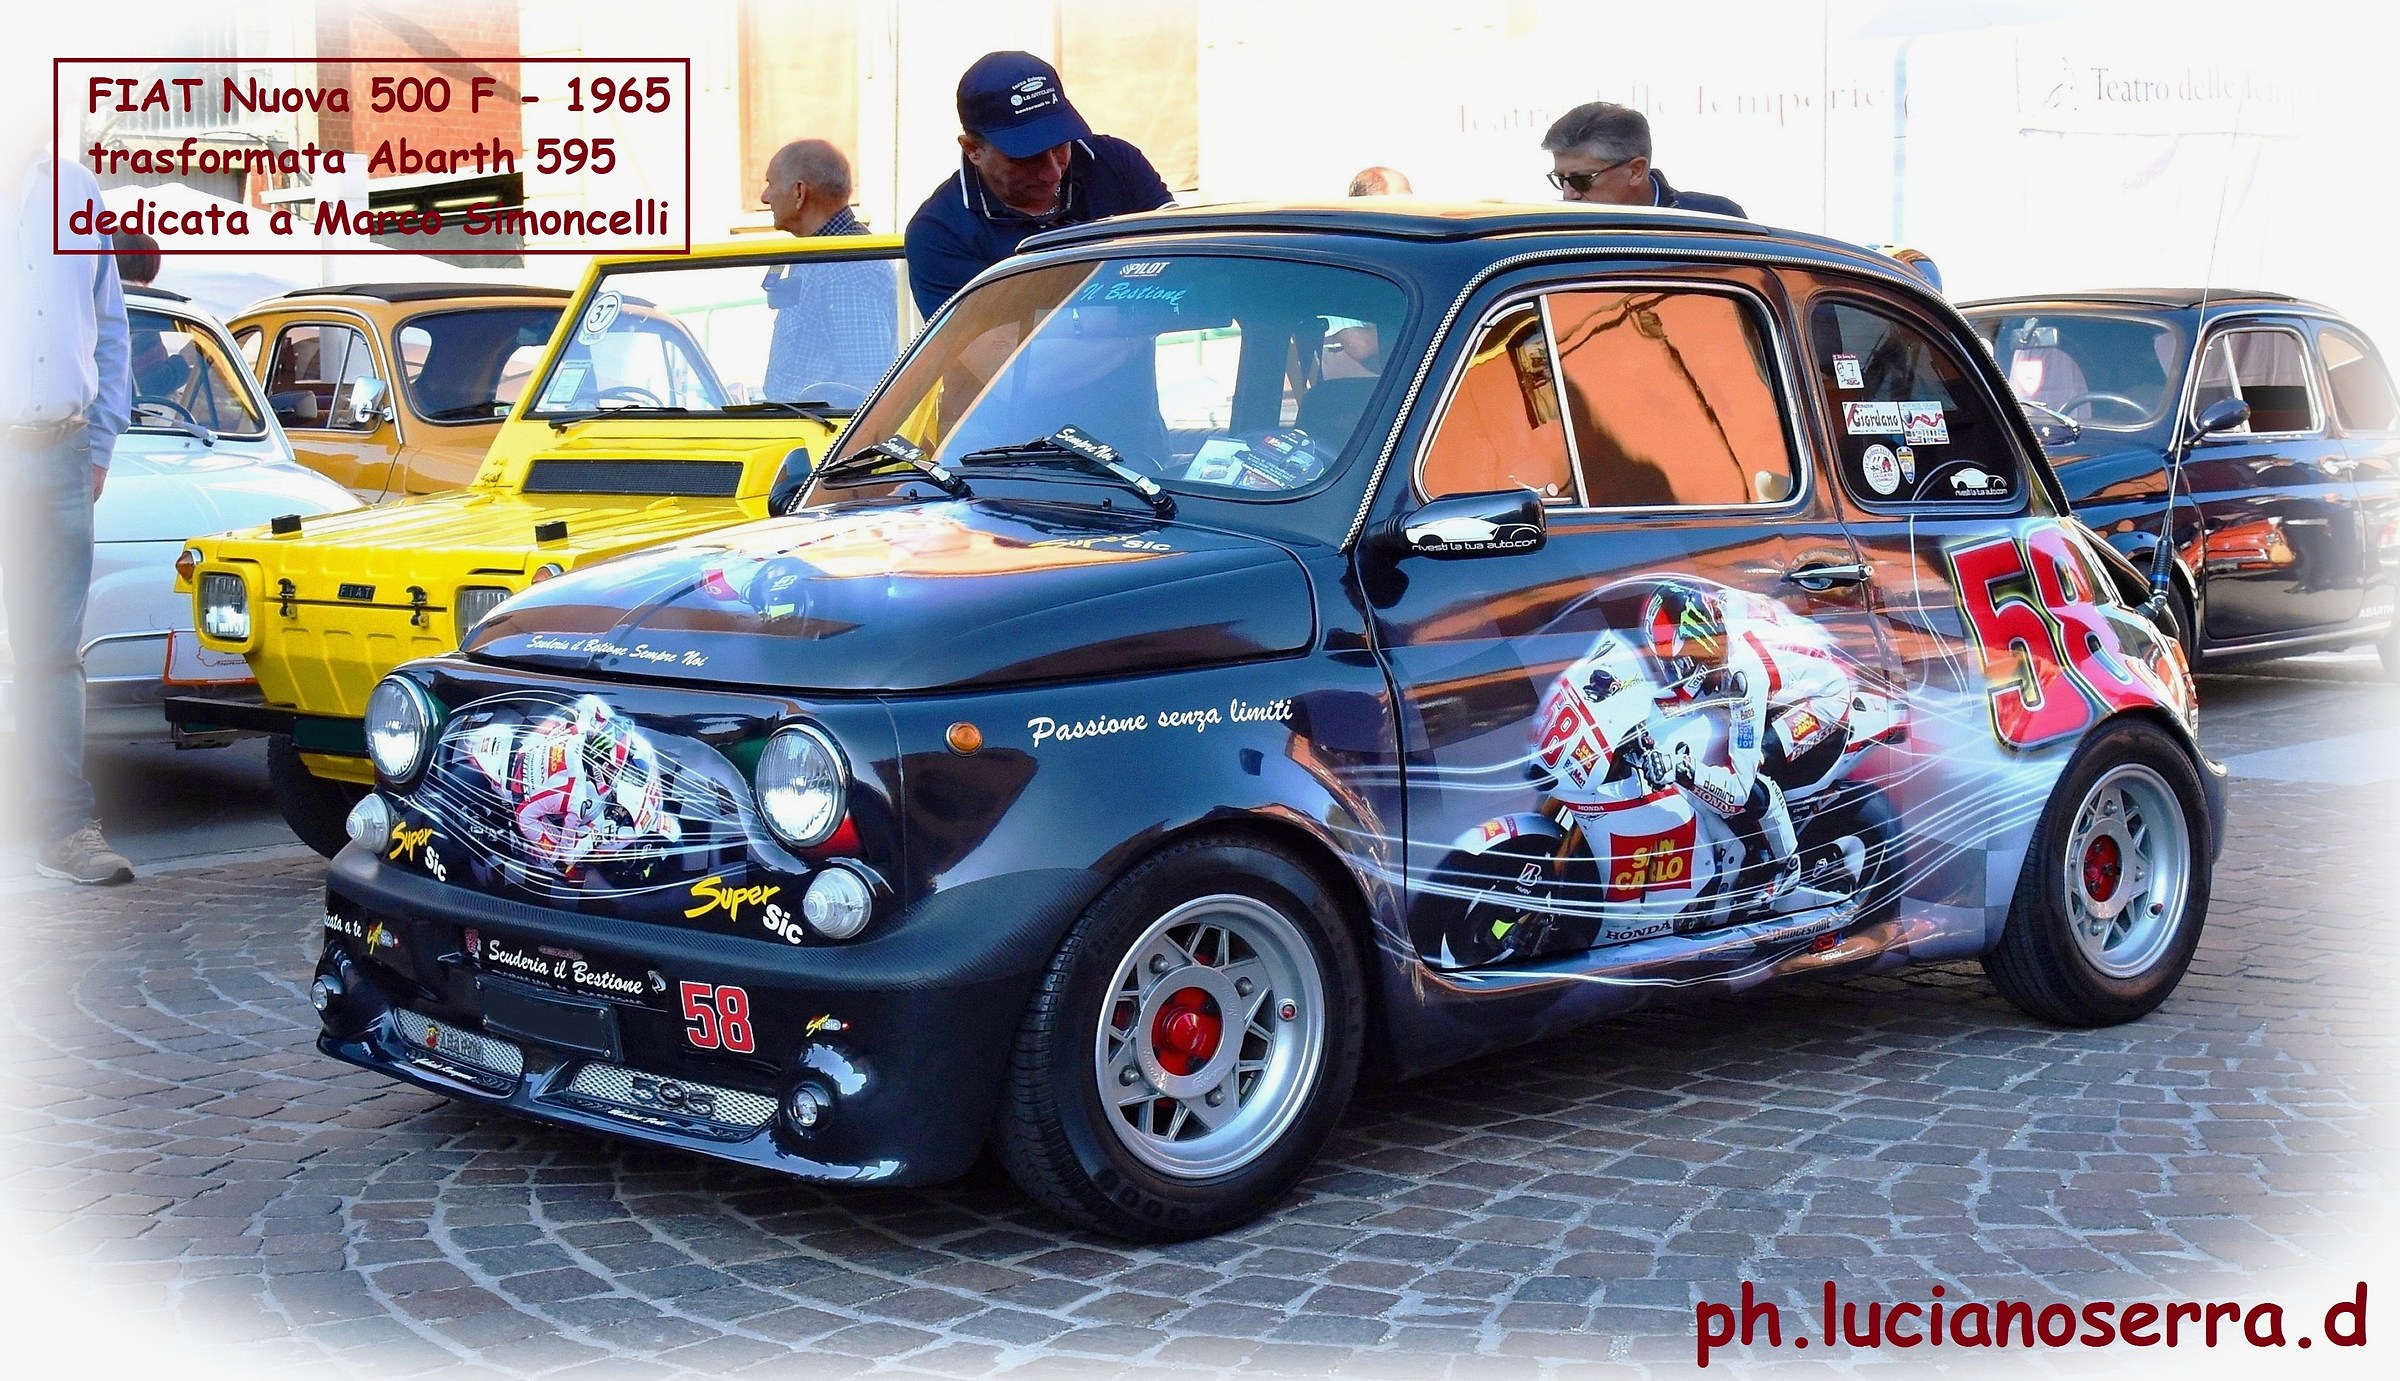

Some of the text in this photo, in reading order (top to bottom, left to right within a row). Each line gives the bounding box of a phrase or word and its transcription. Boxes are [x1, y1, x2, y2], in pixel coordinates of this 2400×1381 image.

[2090, 66, 2169, 102] Teatro
[1105, 281, 1187, 302] Bestione
[589, 303, 616, 324] 37
[1056, 428, 1119, 461] Sempre Noi
[1027, 534, 1142, 549] Super
[1412, 542, 1449, 552] rivesti
[1450, 541, 1463, 551] la
[1465, 541, 1484, 550] tua
[340, 585, 372, 598] FIAT
[2358, 604, 2395, 619] ABARTH
[526, 635, 709, 667] Scuderia il Bestione Sempre Noi
[1949, 519, 2168, 752] 58
[1027, 698, 1294, 749] Passione senza limiti
[1577, 804, 1606, 812] HONDA
[1692, 785, 1738, 814] HONDA
[389, 821, 433, 862] Super
[1632, 837, 1676, 869] SAN
[425, 846, 447, 882] Sic
[684, 875, 781, 923] Super
[345, 921, 352, 935] a
[353, 920, 363, 938] te
[762, 903, 804, 945] Sic
[1605, 920, 1672, 941] HONDA
[1772, 918, 1832, 942] BRIDGESTONE
[488, 939, 550, 976] Scuderia
[553, 960, 567, 979] il
[572, 960, 644, 995] Bestione
[680, 981, 756, 1055] 58
[632, 1076, 717, 1118] 595
